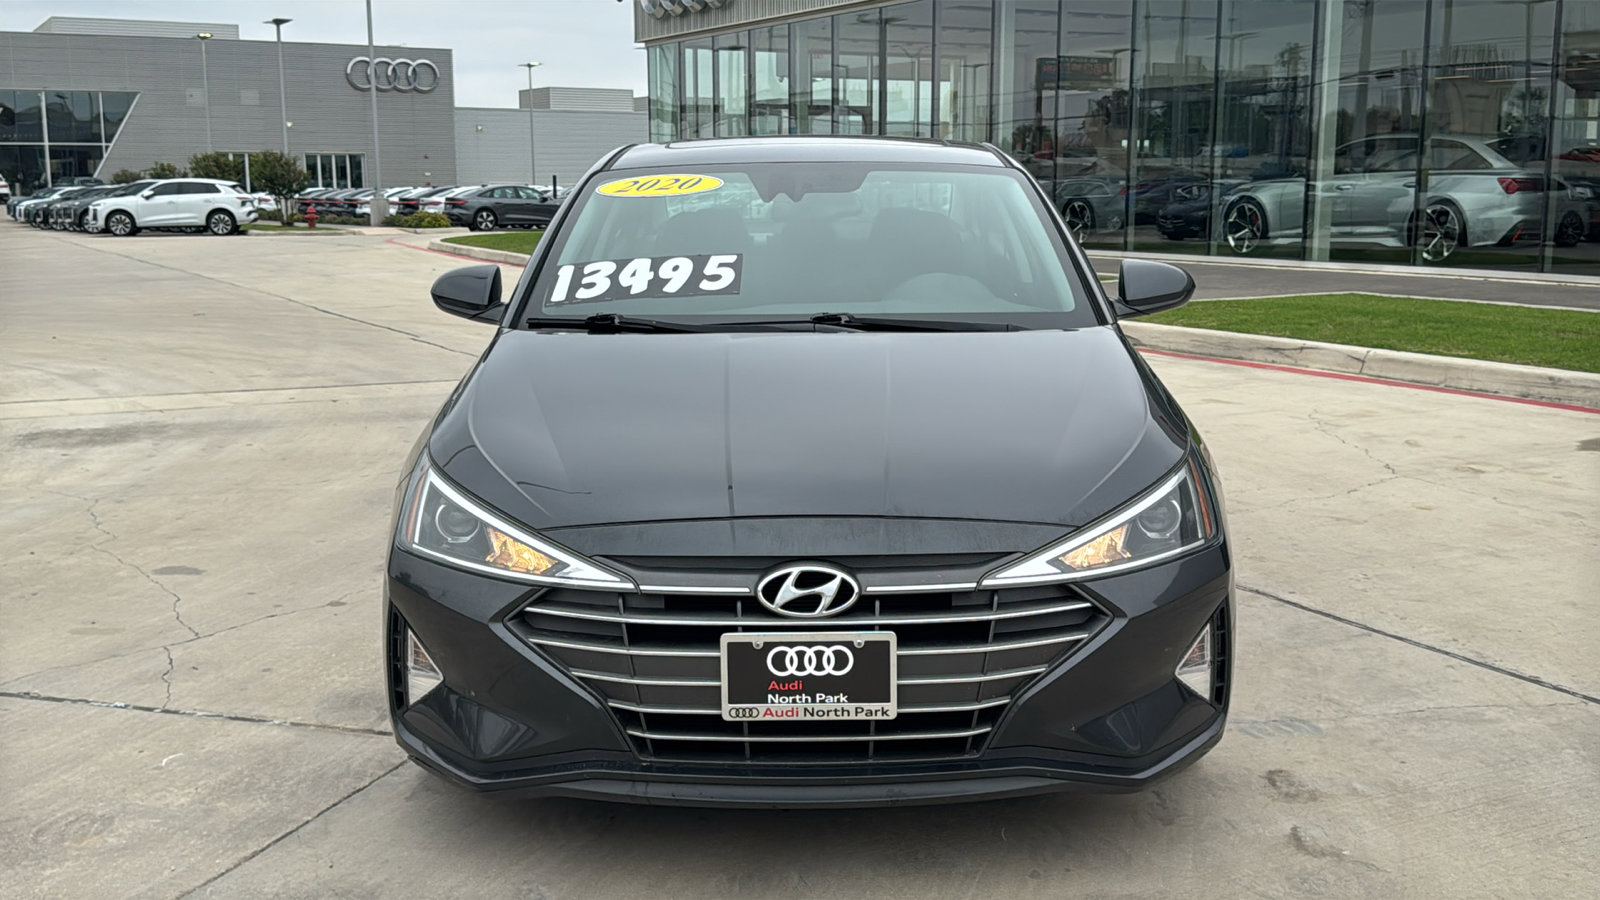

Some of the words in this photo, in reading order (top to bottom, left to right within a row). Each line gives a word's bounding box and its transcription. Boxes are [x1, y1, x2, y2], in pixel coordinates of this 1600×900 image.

[615, 177, 703, 193] 2020
[551, 254, 738, 302] 13495
[768, 680, 803, 691] Audi
[768, 694, 811, 704] North
[816, 693, 848, 703] Park
[763, 707, 799, 718] Audi
[803, 707, 850, 718] North
[855, 706, 889, 717] Park
